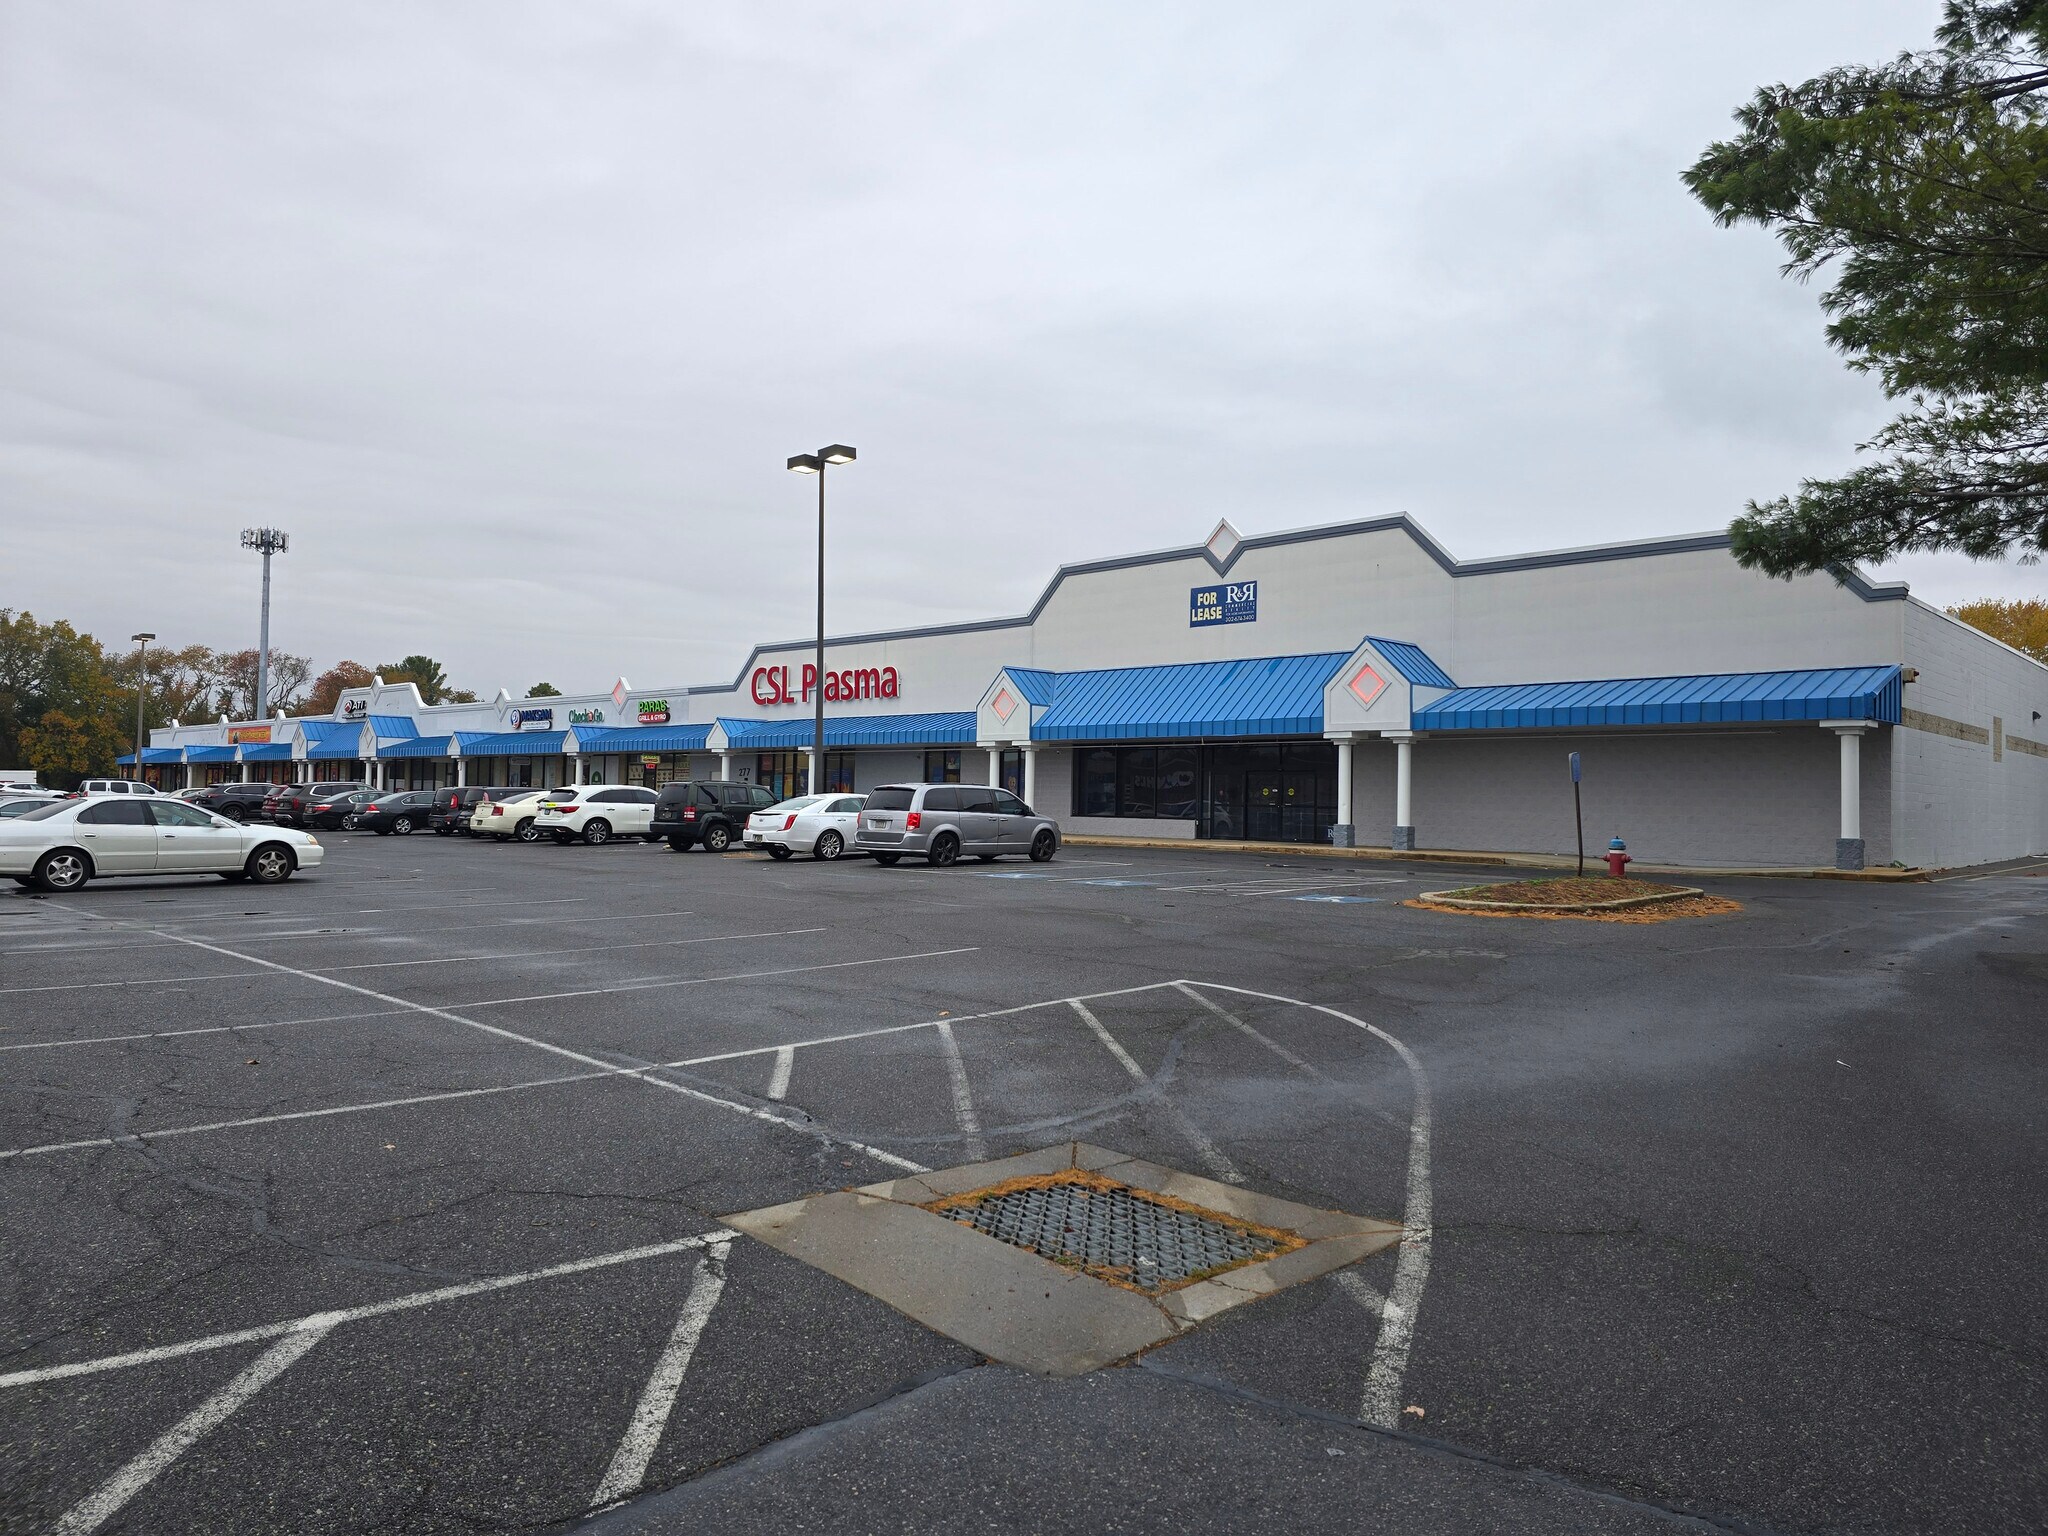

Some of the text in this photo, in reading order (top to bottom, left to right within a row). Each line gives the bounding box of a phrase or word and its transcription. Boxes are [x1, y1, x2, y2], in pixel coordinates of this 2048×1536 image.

[1197, 592, 1217, 606] FOR
[1192, 606, 1222, 622] LEASE
[751, 663, 900, 705] CSL Pasma
[638, 699, 669, 713] PARAS
[638, 714, 650, 722] GRILL
[654, 713, 667, 721] GYRO
[739, 768, 751, 777] 277
